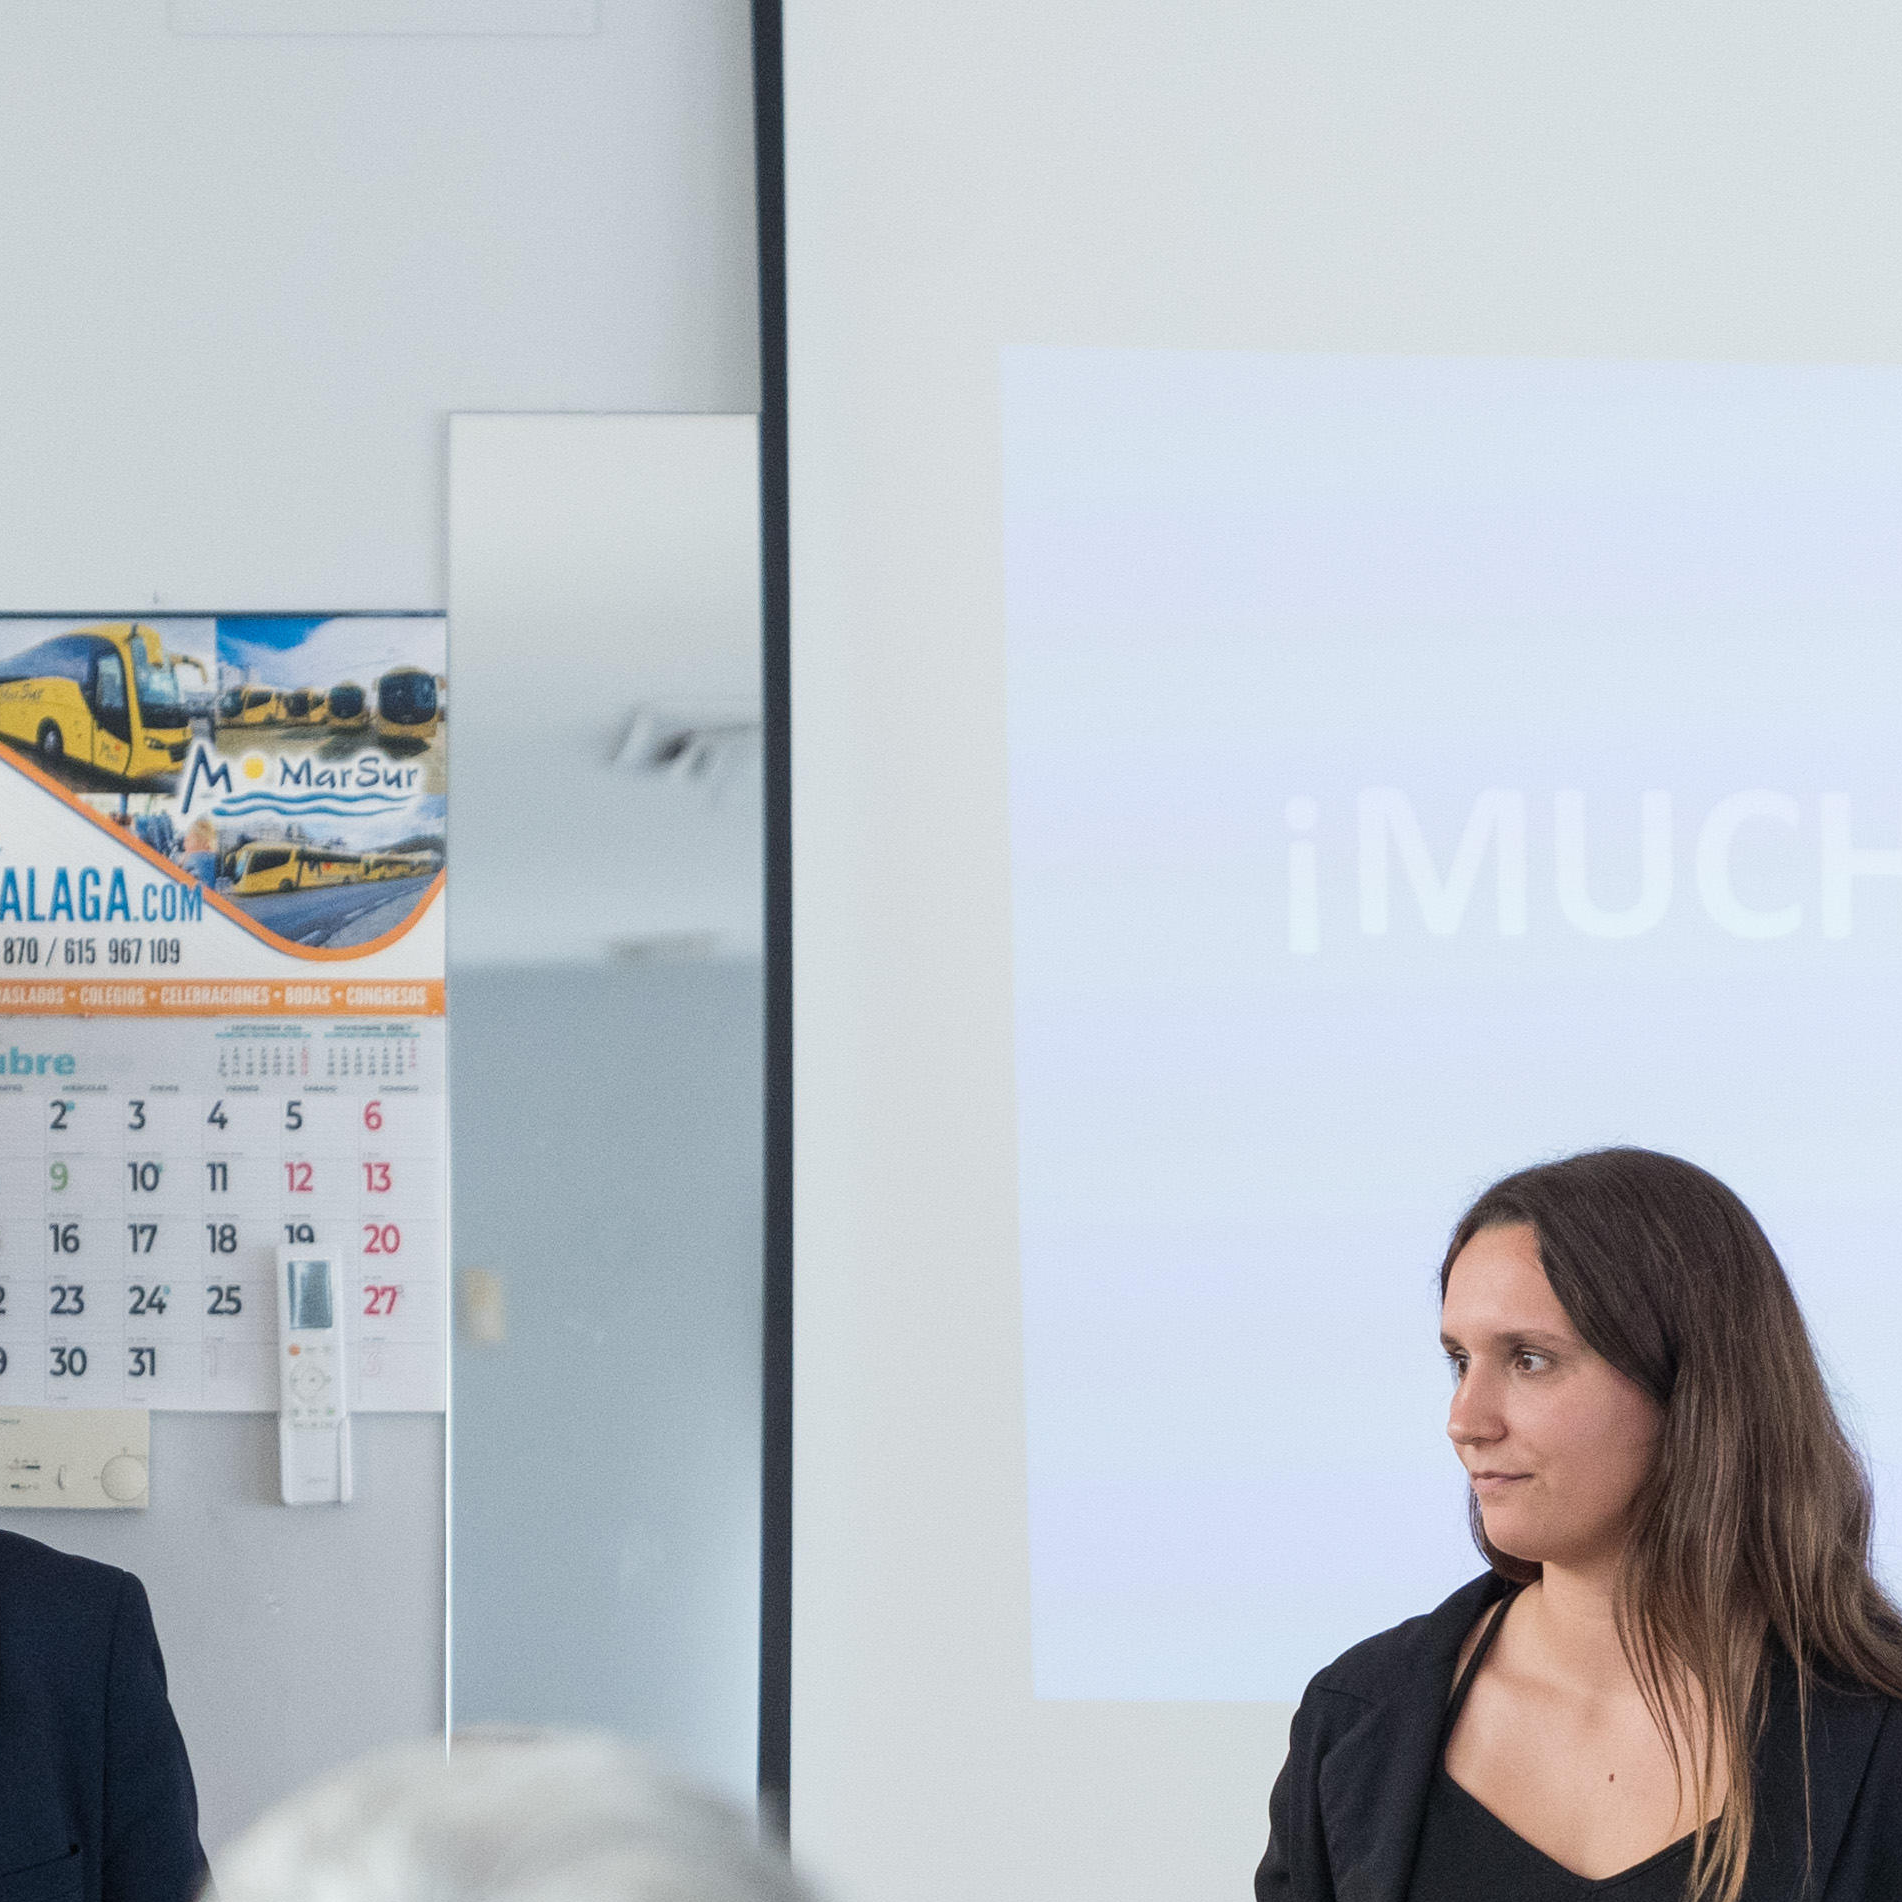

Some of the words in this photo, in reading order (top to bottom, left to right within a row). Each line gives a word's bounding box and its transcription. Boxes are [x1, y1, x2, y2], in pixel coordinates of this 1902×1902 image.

[279, 755, 419, 789] MarSur
[3, 937, 38, 965] 870
[64, 938, 96, 965] 615
[108, 938, 142, 966] 967
[150, 938, 181, 965] 109
[80, 985, 146, 1006] COLEGIOS
[160, 986, 270, 1006] CELEBRACIONES
[347, 985, 427, 1005] CONGRESOS
[49, 1100, 69, 1130] 2
[127, 1100, 146, 1130] 3
[206, 1100, 228, 1130] 4
[284, 1100, 303, 1130] 5
[363, 1100, 383, 1130] 6
[49, 1162, 69, 1192] 9
[127, 1162, 160, 1192] 10
[206, 1162, 228, 1192] 11
[284, 1162, 313, 1192] 12
[363, 1162, 392, 1192] 13
[49, 1223, 81, 1253] 16
[127, 1223, 158, 1253] 17
[206, 1223, 238, 1253] 18
[362, 1223, 401, 1253] 20
[49, 1285, 85, 1315] 23
[127, 1285, 167, 1315] 24
[206, 1285, 243, 1315] 25
[363, 1285, 398, 1315] 27
[49, 1347, 87, 1376] 30
[127, 1347, 157, 1376] 31
